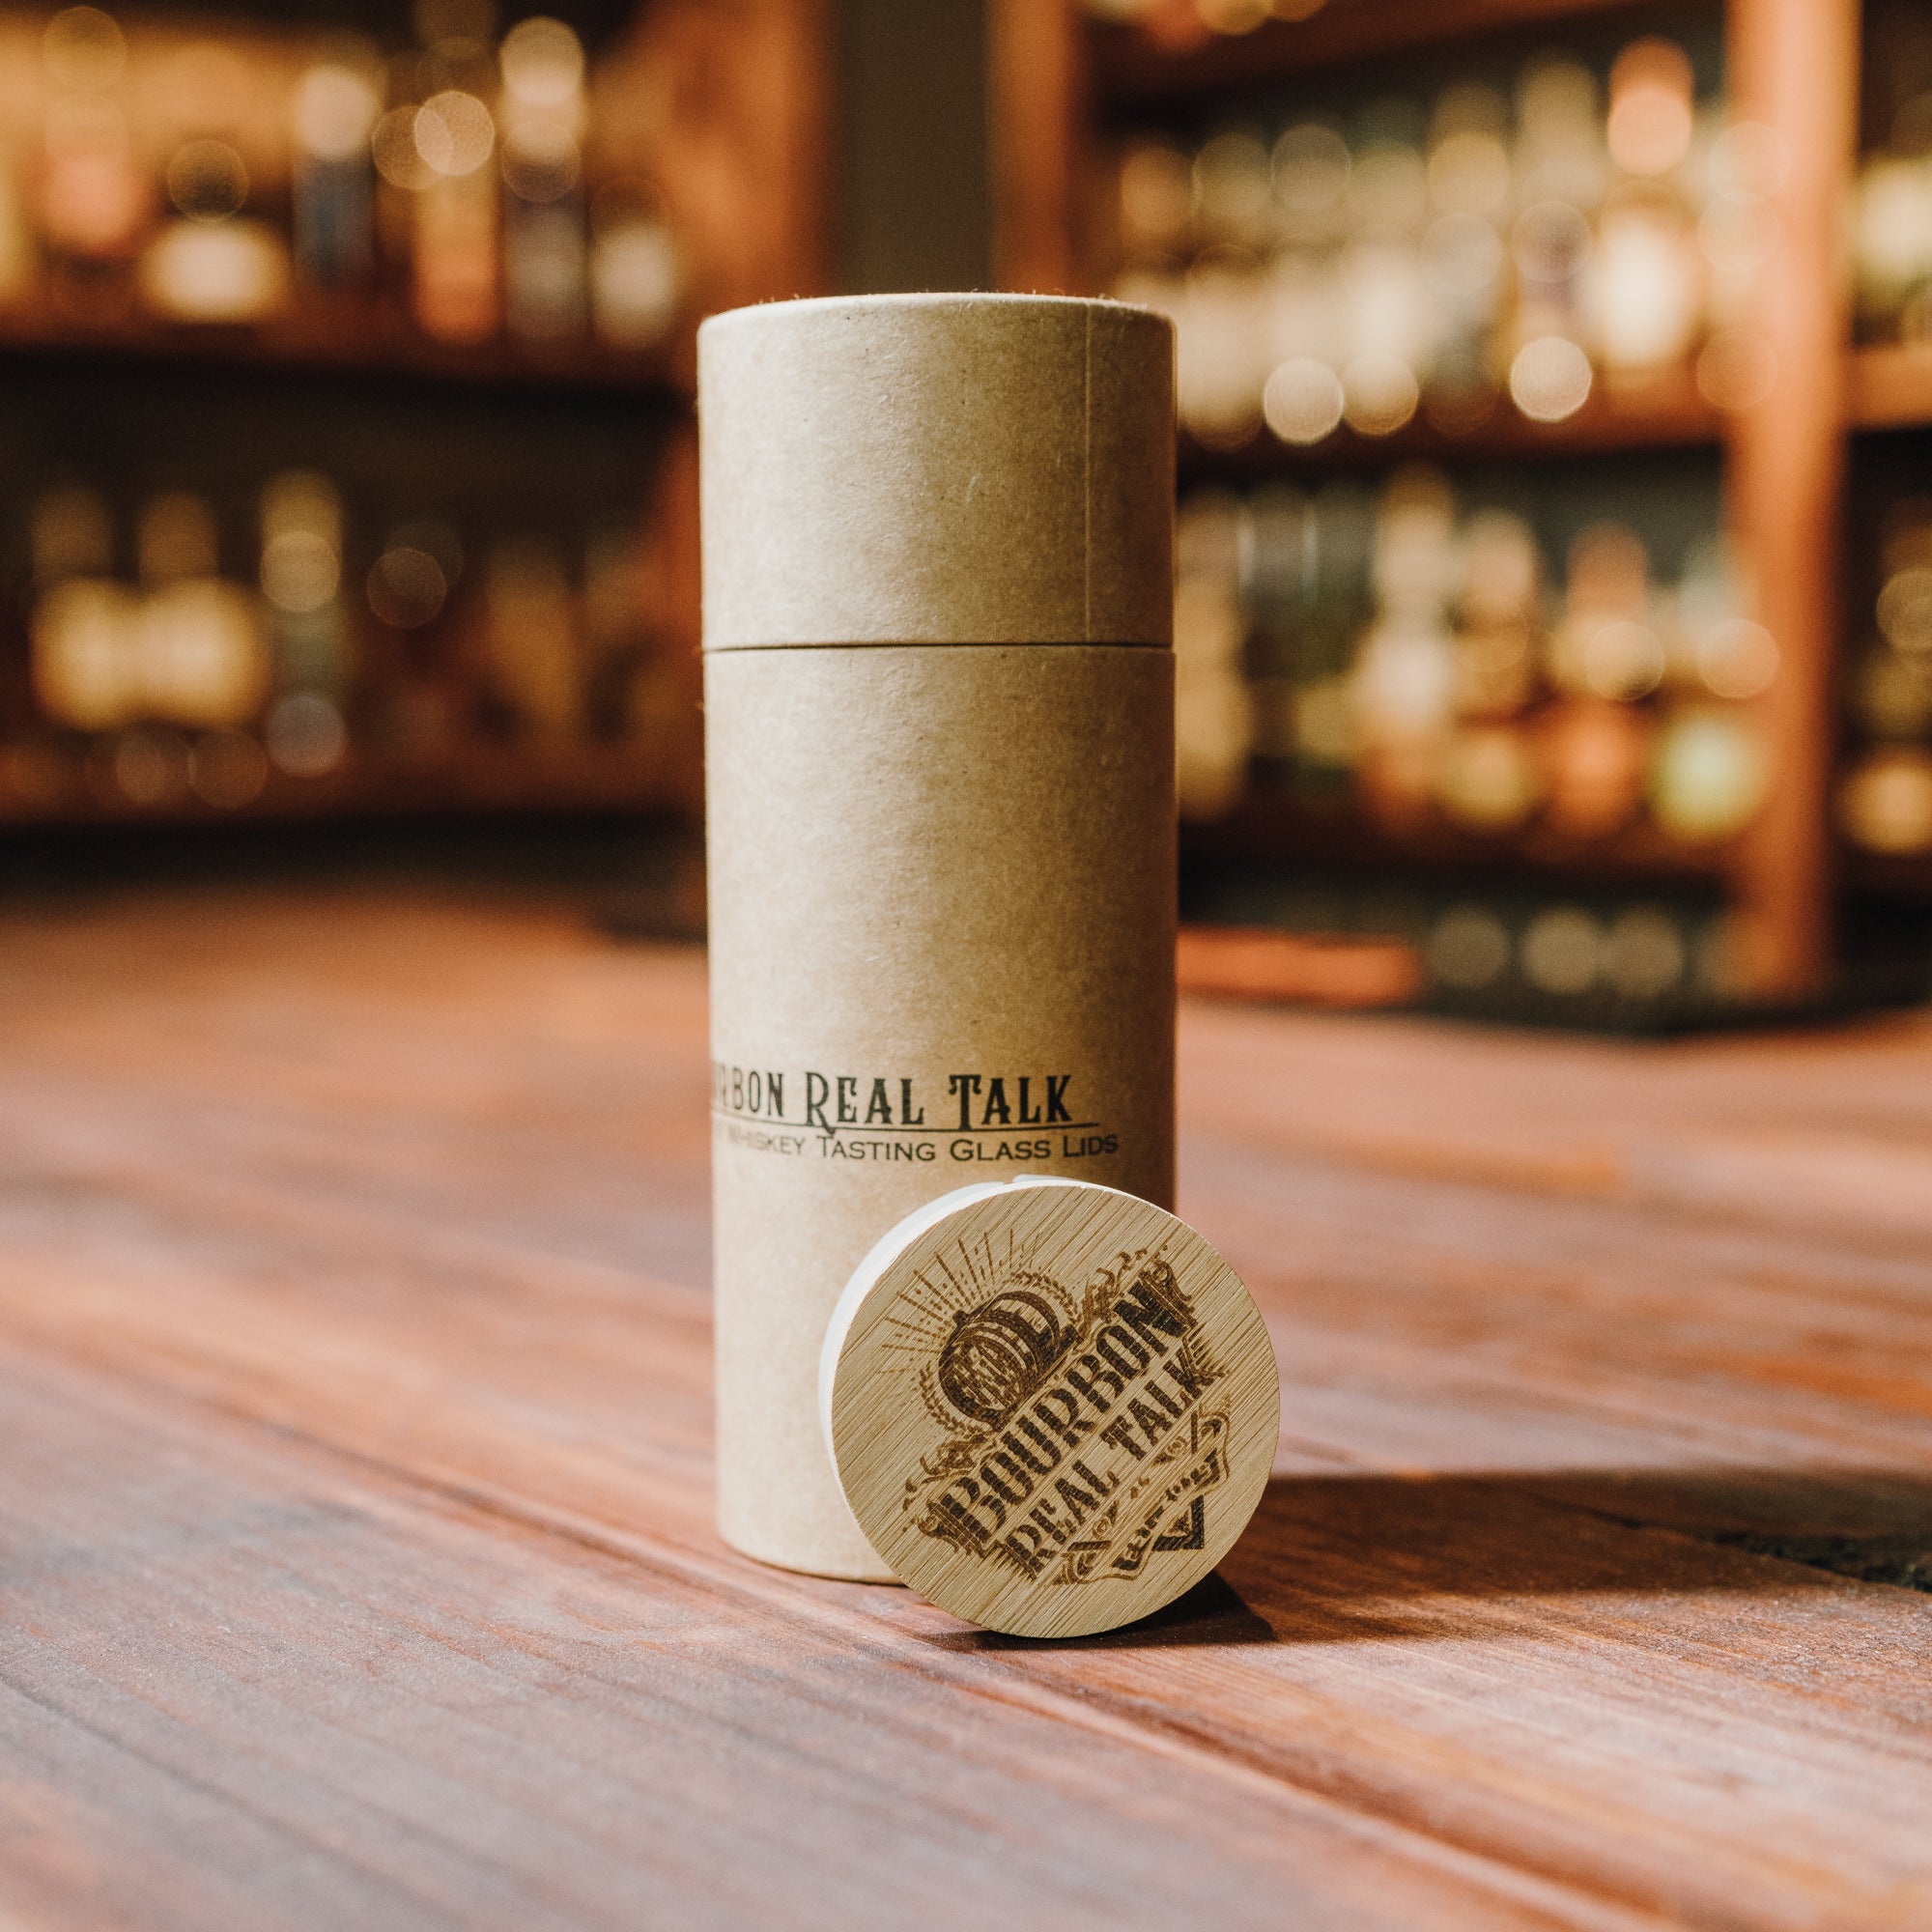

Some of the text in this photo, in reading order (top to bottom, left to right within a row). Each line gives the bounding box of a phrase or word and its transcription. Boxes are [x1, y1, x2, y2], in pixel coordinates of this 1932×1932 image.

[728, 1123, 1119, 1161] WHISKEY TASTING GLASS LIDS
[806, 1071, 923, 1134] REAL
[949, 1074, 1071, 1131] TALK
[940, 1280, 1187, 1543] BOURBON
[1004, 1459, 1121, 1574] REAL
[1099, 1349, 1209, 1461] TALK
